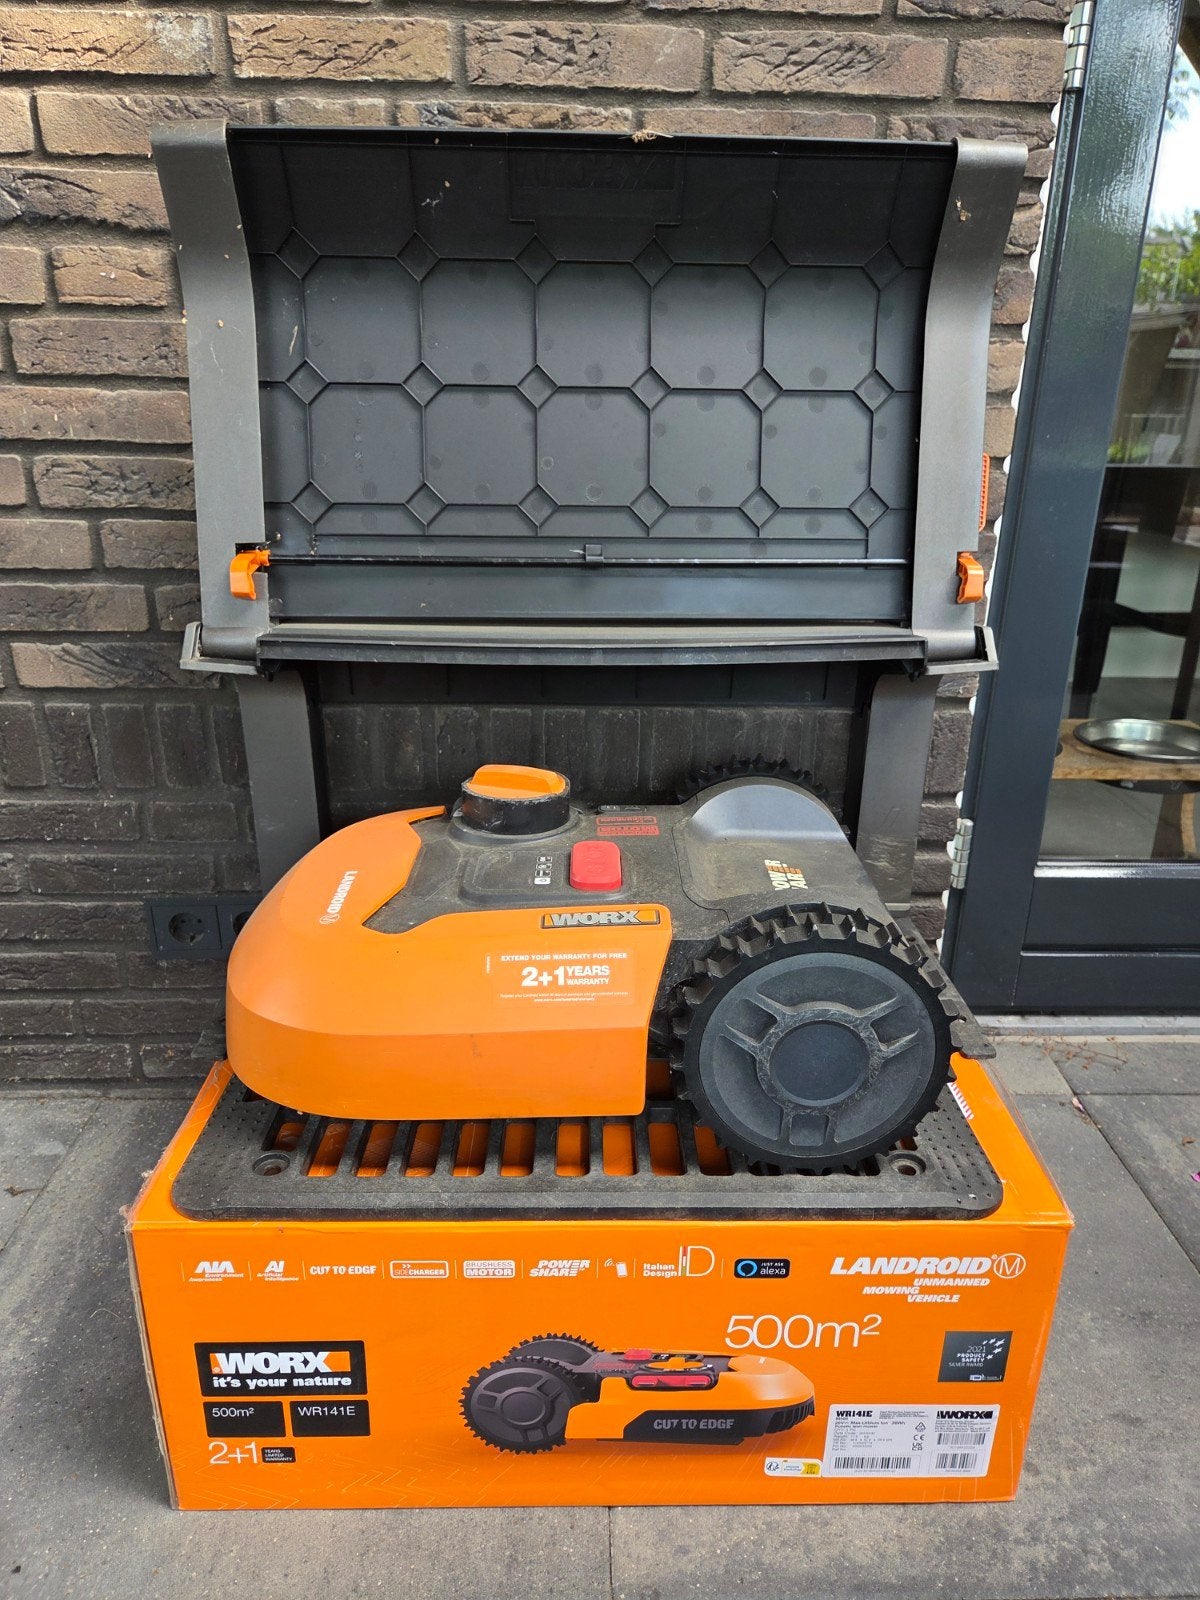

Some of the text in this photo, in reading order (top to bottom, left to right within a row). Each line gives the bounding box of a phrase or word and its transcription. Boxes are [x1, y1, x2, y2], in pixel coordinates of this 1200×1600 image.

[552, 910, 641, 926] WORX
[521, 965, 610, 987] 2+1 YEARS
[566, 978, 609, 986] WARRANTY
[264, 1260, 285, 1273] AI
[537, 1260, 591, 1269] POWER
[310, 1265, 330, 1275] CUT
[331, 1265, 346, 1275] TO
[466, 1268, 513, 1277] MOTOR
[529, 1268, 578, 1277] SHARE
[643, 1270, 678, 1278] Design
[914, 1278, 990, 1287] UNMANNED
[862, 1286, 920, 1295] MOWING
[907, 1295, 960, 1303] VEHICLE
[216, 1351, 333, 1375] WORX
[212, 1376, 352, 1390] it's your nature
[297, 1406, 356, 1416] WR141E
[836, 1410, 873, 1418] WR141E
[938, 1410, 985, 1420] WORX
[653, 1419, 679, 1430] CUT
[681, 1419, 698, 1430] TO
[208, 1441, 258, 1464] 2+1
